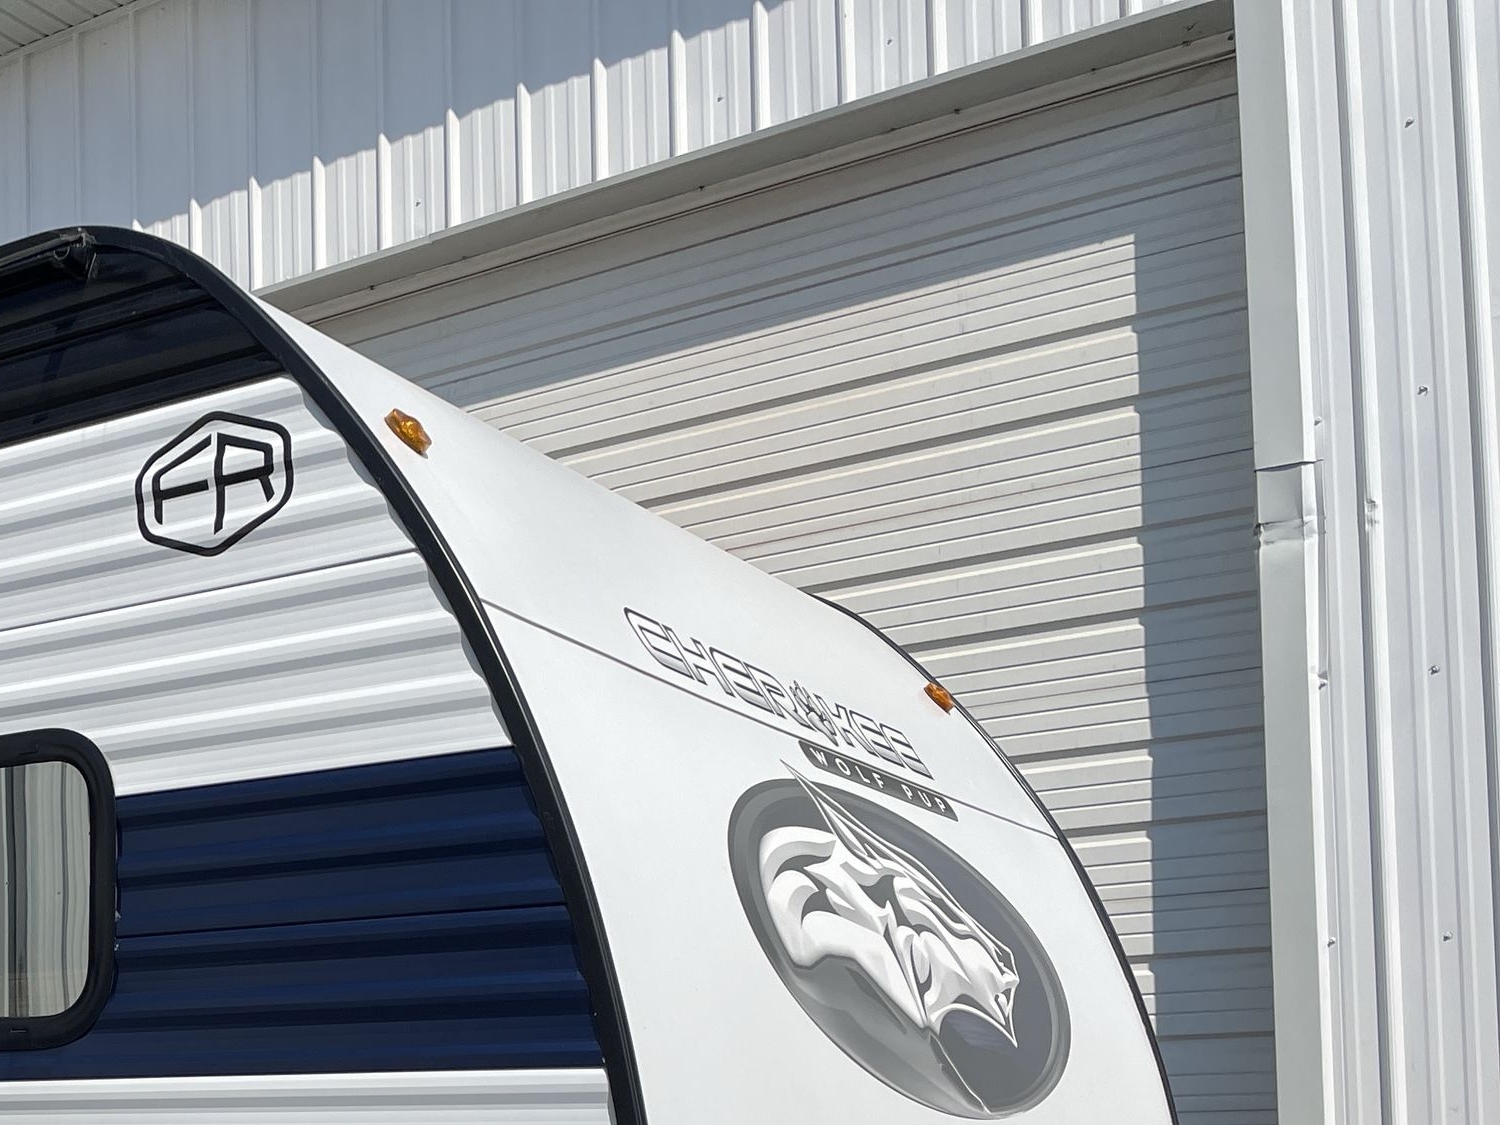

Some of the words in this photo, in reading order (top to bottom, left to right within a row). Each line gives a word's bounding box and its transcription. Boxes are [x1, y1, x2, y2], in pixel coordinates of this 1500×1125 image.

[623, 607, 935, 781] CHEROKEE
[809, 747, 887, 789] WOLF
[902, 786, 949, 813] PUP
